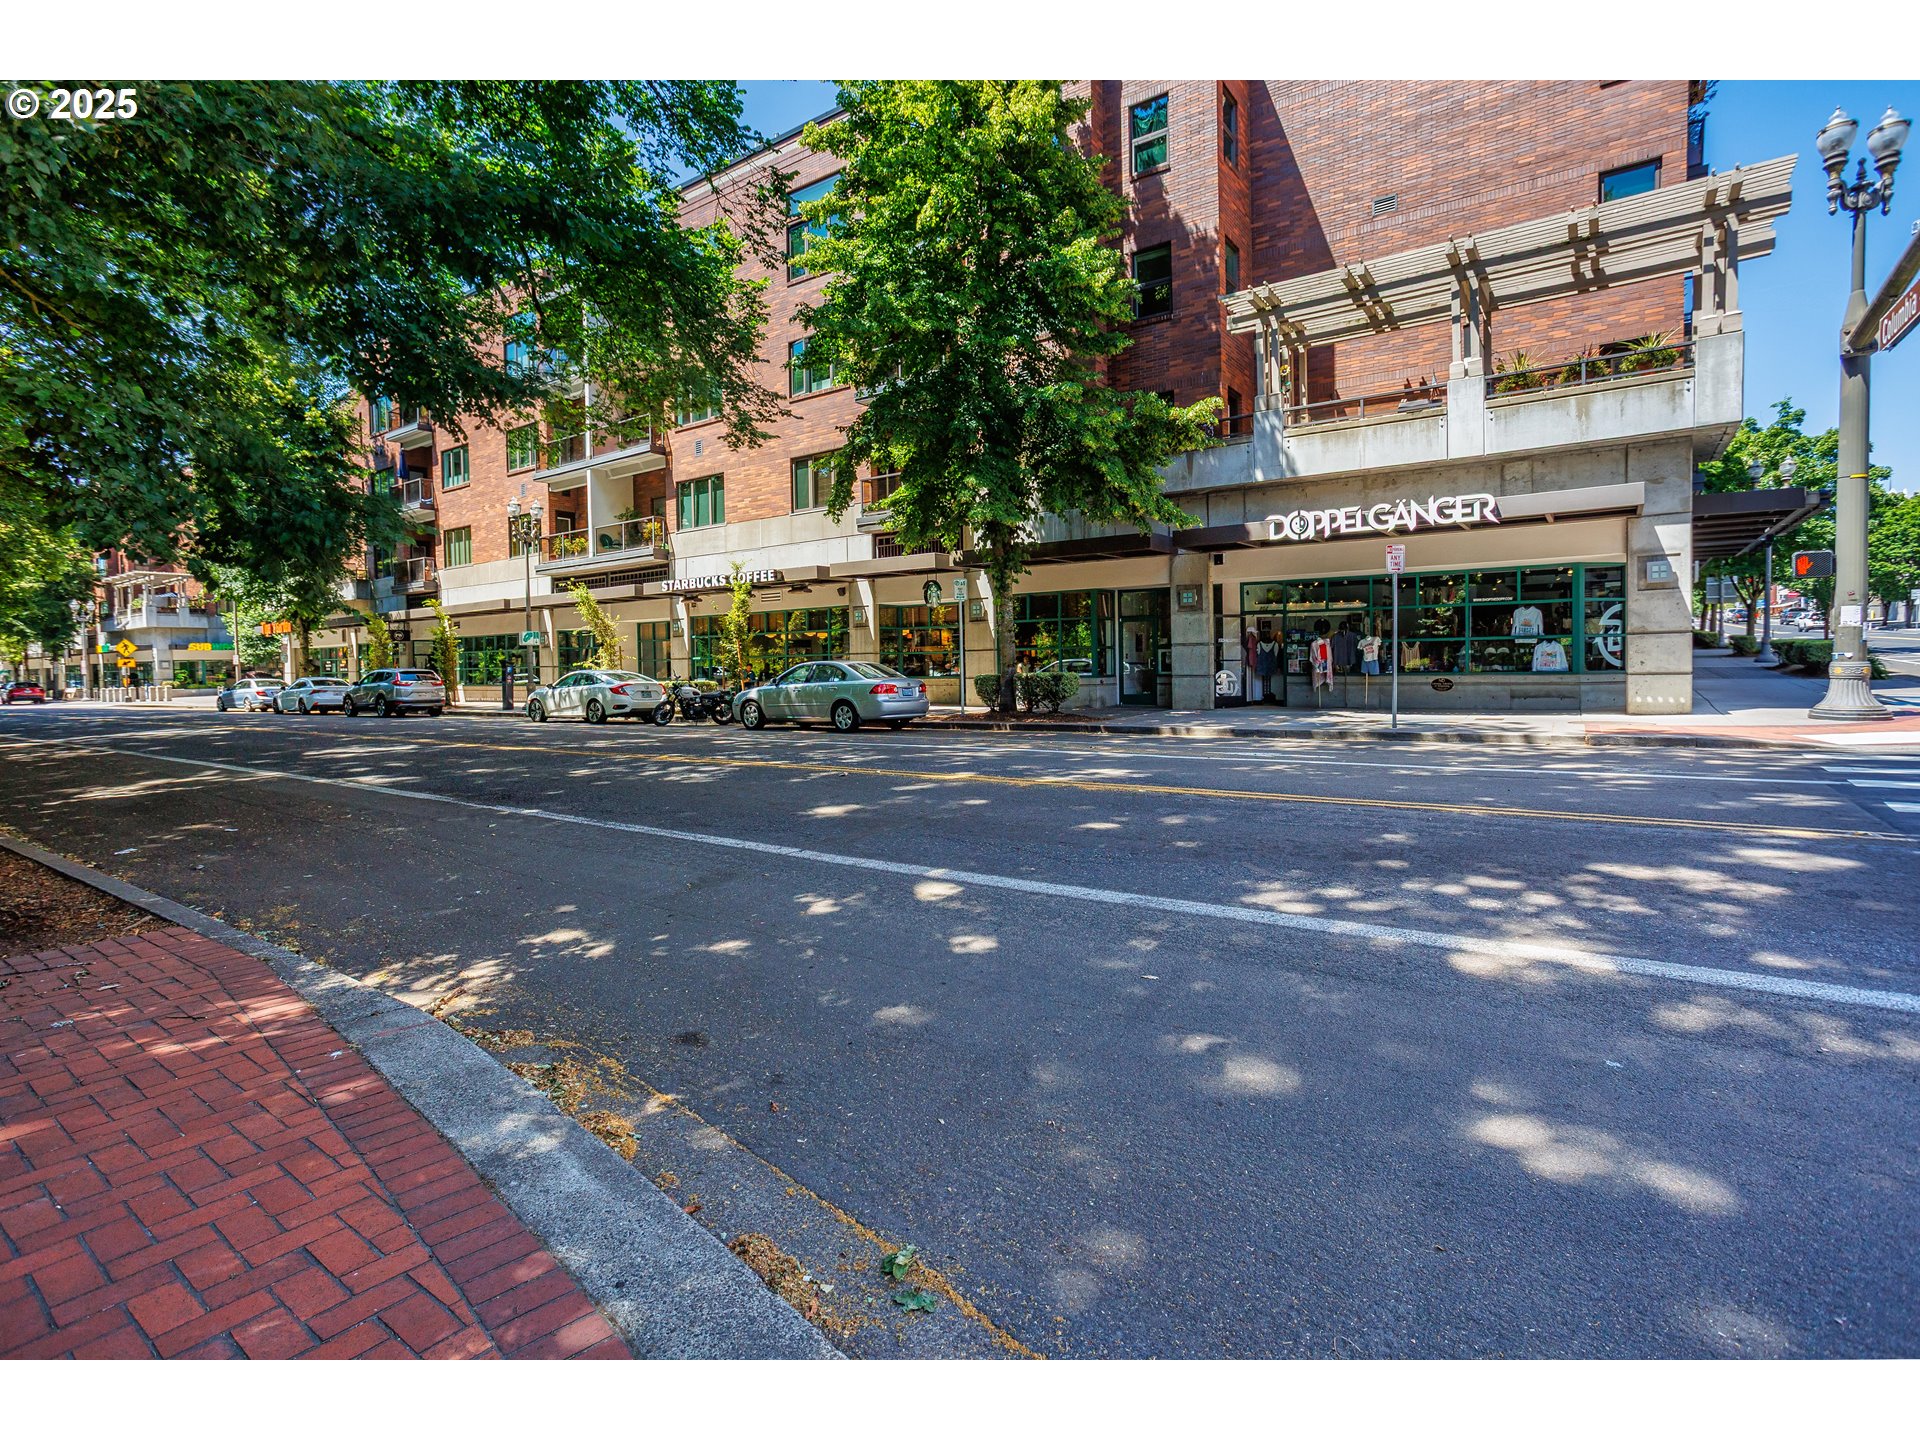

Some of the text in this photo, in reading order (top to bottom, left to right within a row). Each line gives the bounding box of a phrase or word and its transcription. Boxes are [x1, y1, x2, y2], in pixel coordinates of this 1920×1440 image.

[1882, 292, 1917, 344] Columbia
[661, 569, 775, 592] STARBUCKS COFFEE
